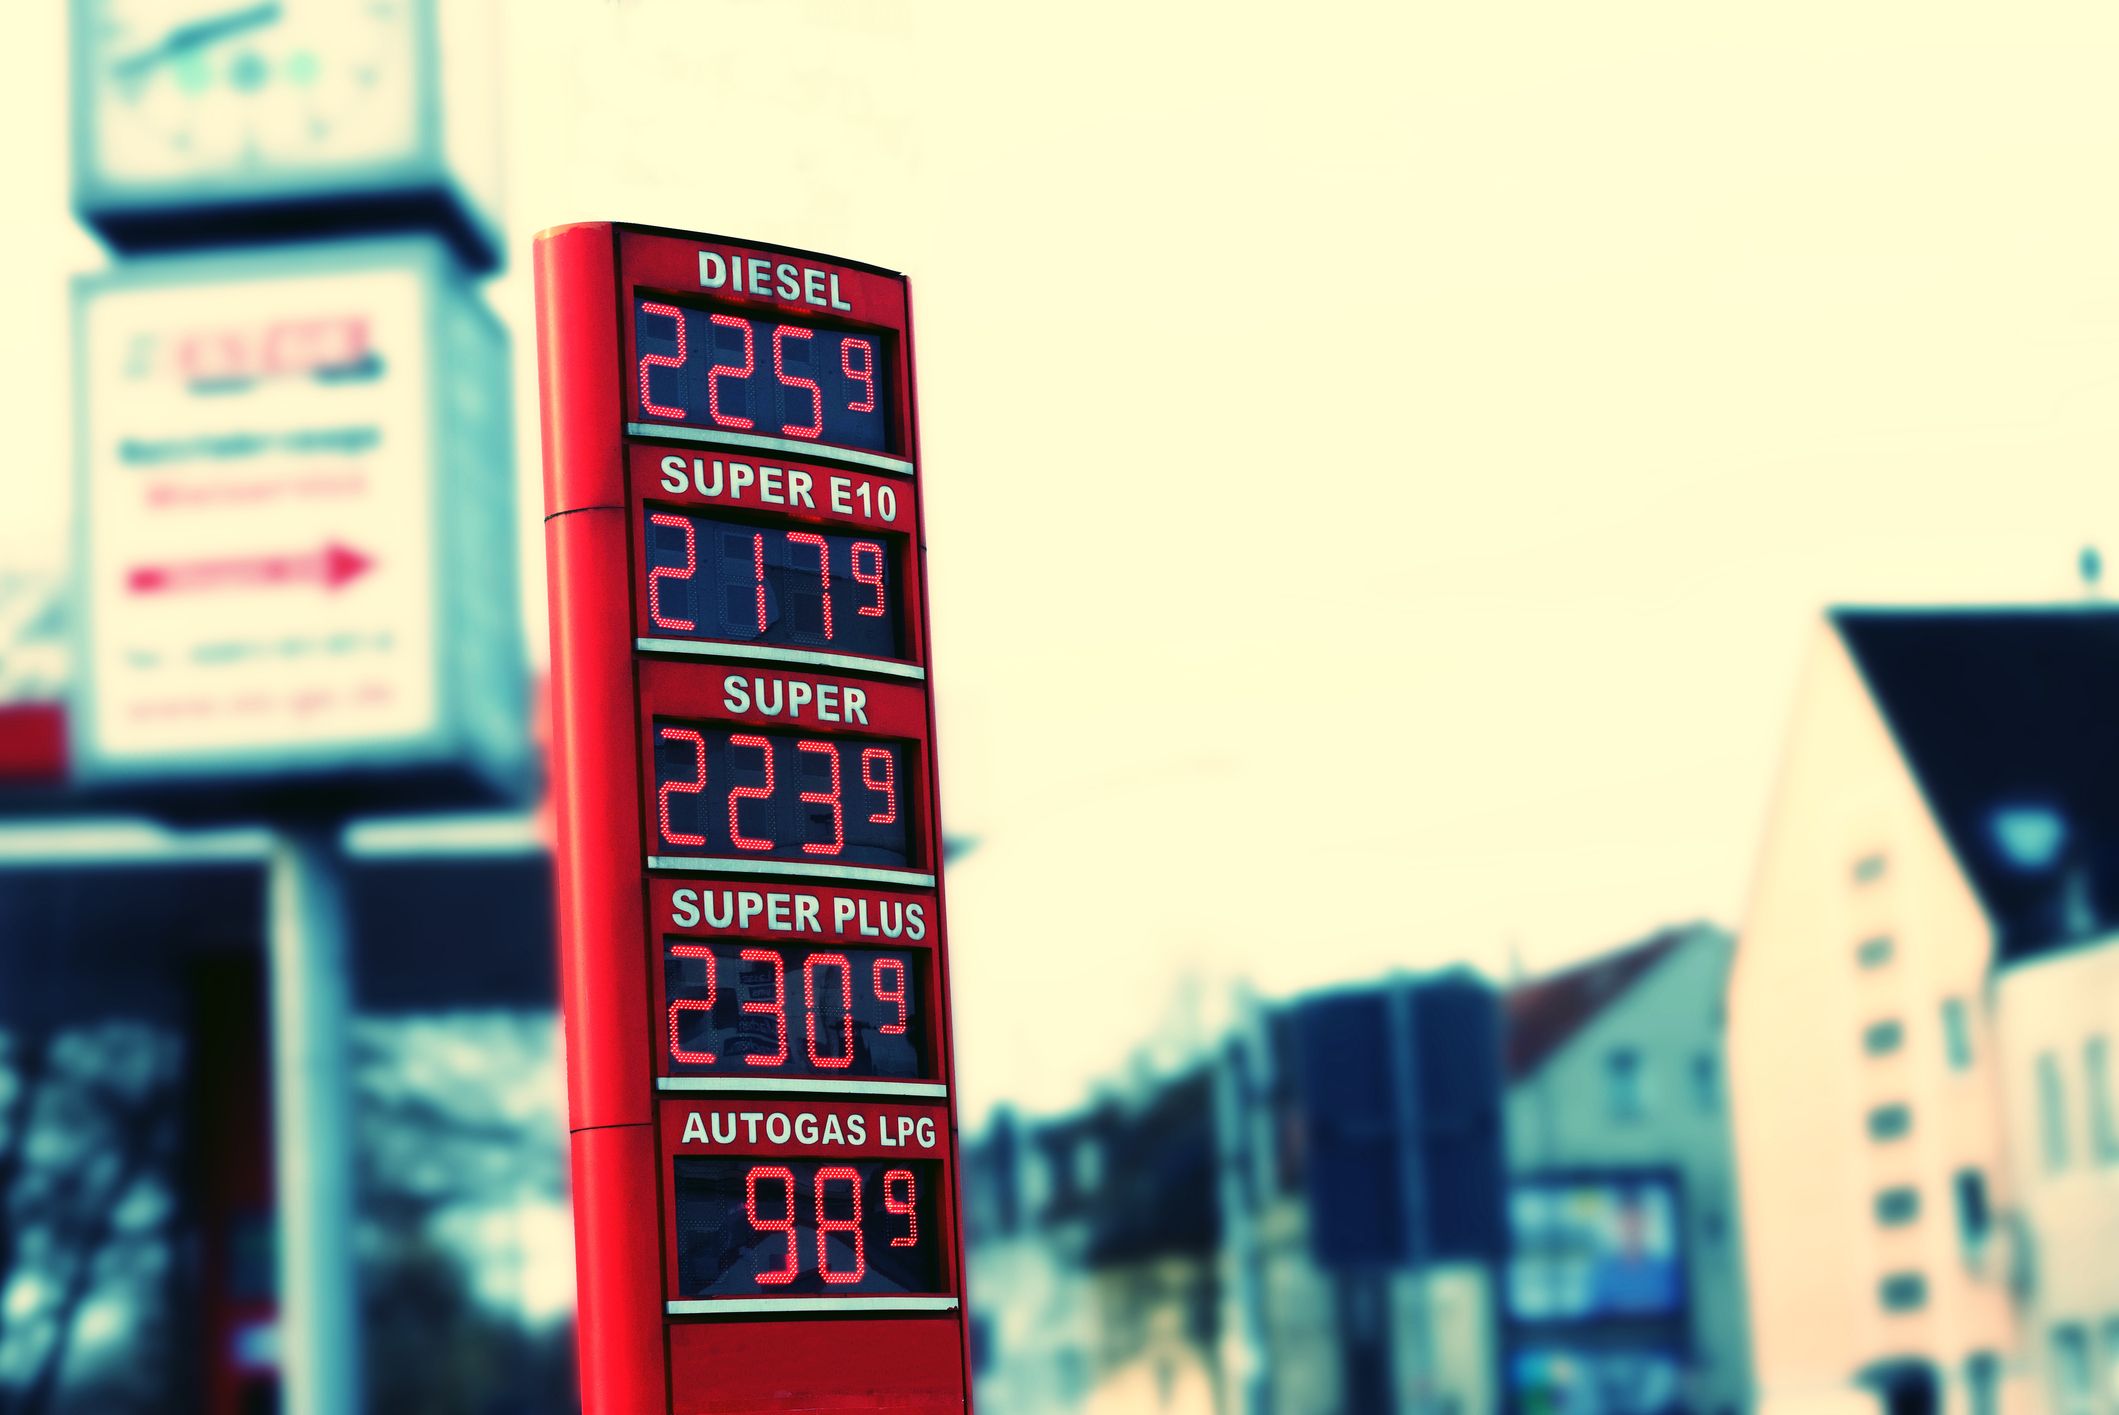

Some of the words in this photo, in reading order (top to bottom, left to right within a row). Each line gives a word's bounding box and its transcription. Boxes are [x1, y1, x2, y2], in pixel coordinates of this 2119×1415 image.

[698, 250, 852, 312] DIESEL
[660, 455, 817, 510] SUPER
[830, 476, 897, 522] E10
[723, 675, 869, 725] SUPER
[672, 888, 822, 933] SUPER
[833, 897, 926, 941] PLUS
[681, 1112, 867, 1146] AUTOGAS
[879, 1115, 936, 1149] LPG
